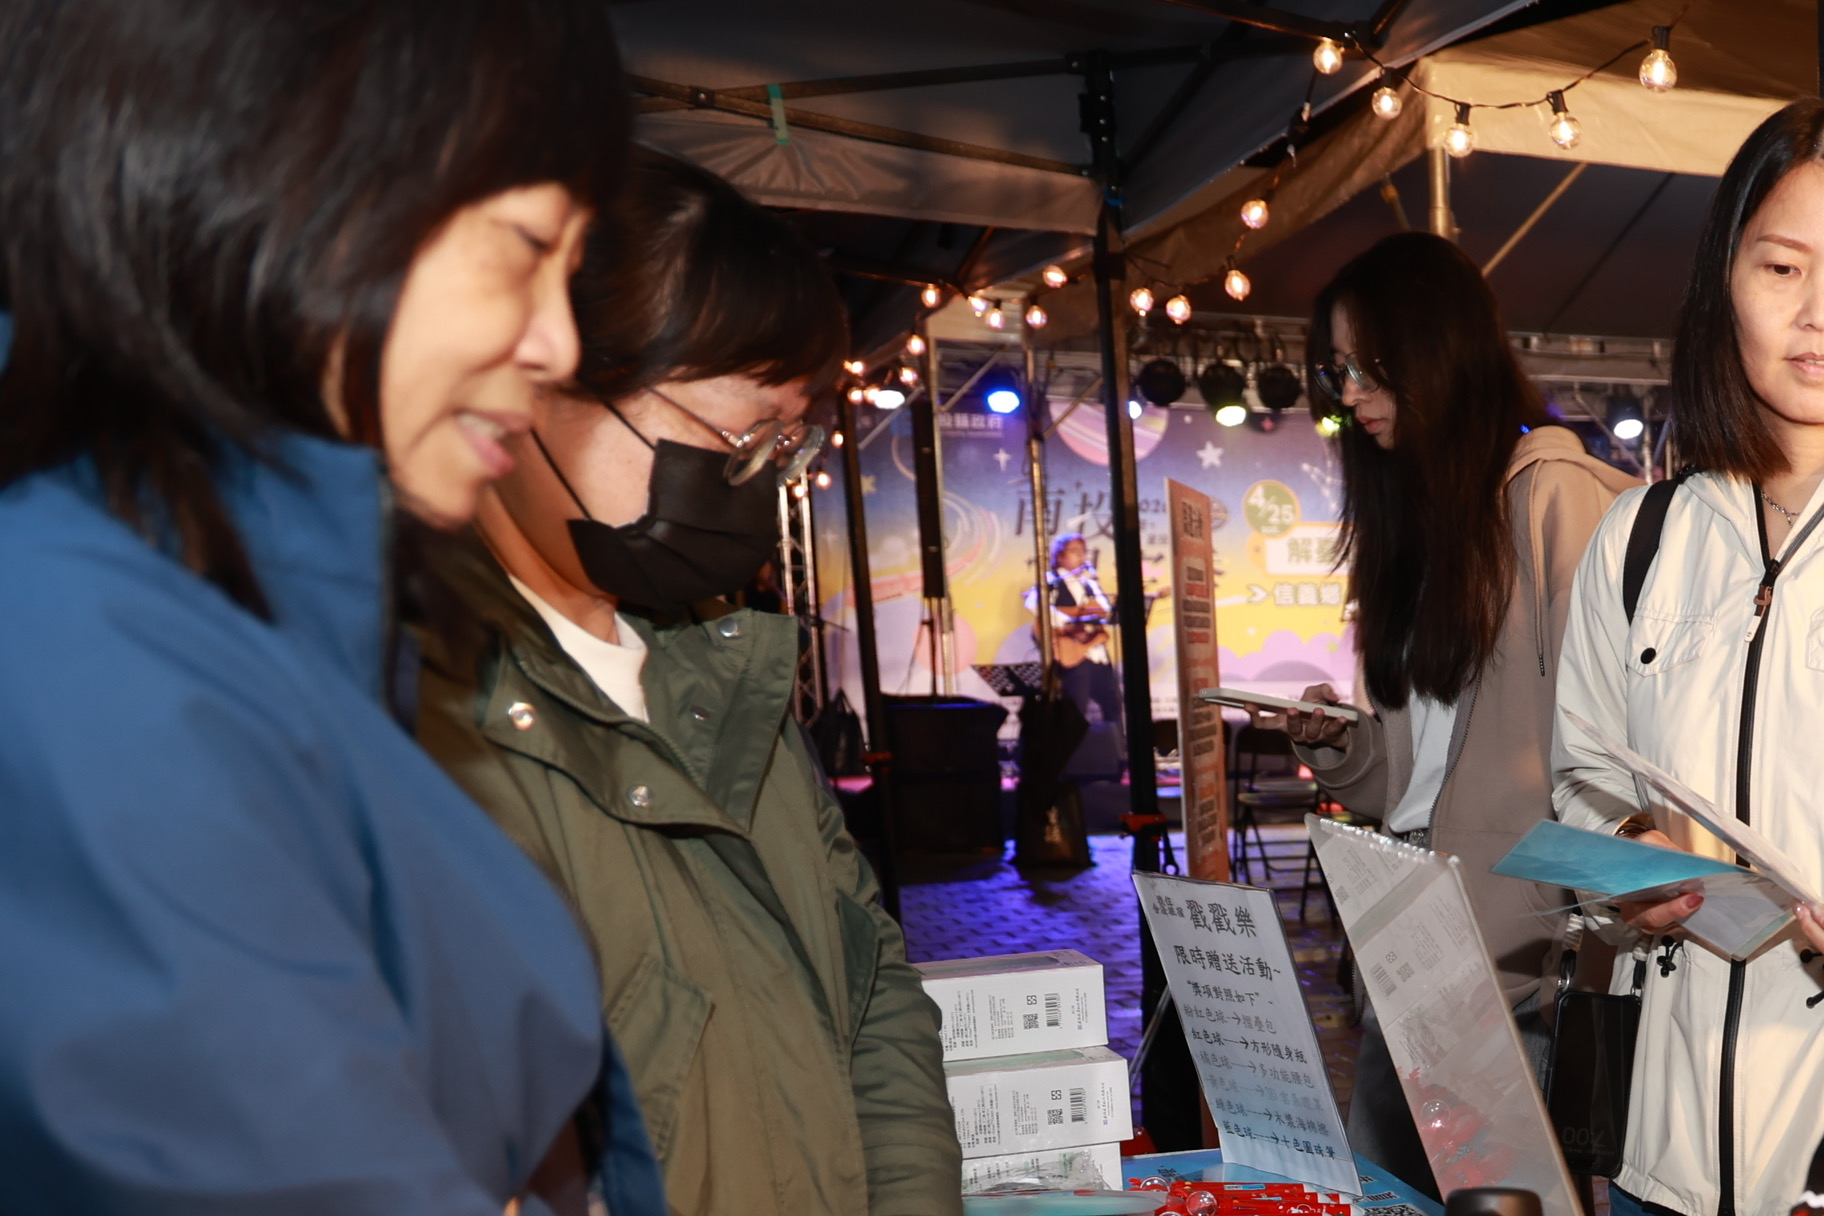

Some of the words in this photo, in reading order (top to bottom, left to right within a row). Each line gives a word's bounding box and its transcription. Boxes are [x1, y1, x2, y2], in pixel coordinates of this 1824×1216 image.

[939, 412, 1004, 430] 投縣政府
[1248, 485, 1294, 524] 4/25
[1186, 899, 1257, 938] 戳戳樂
